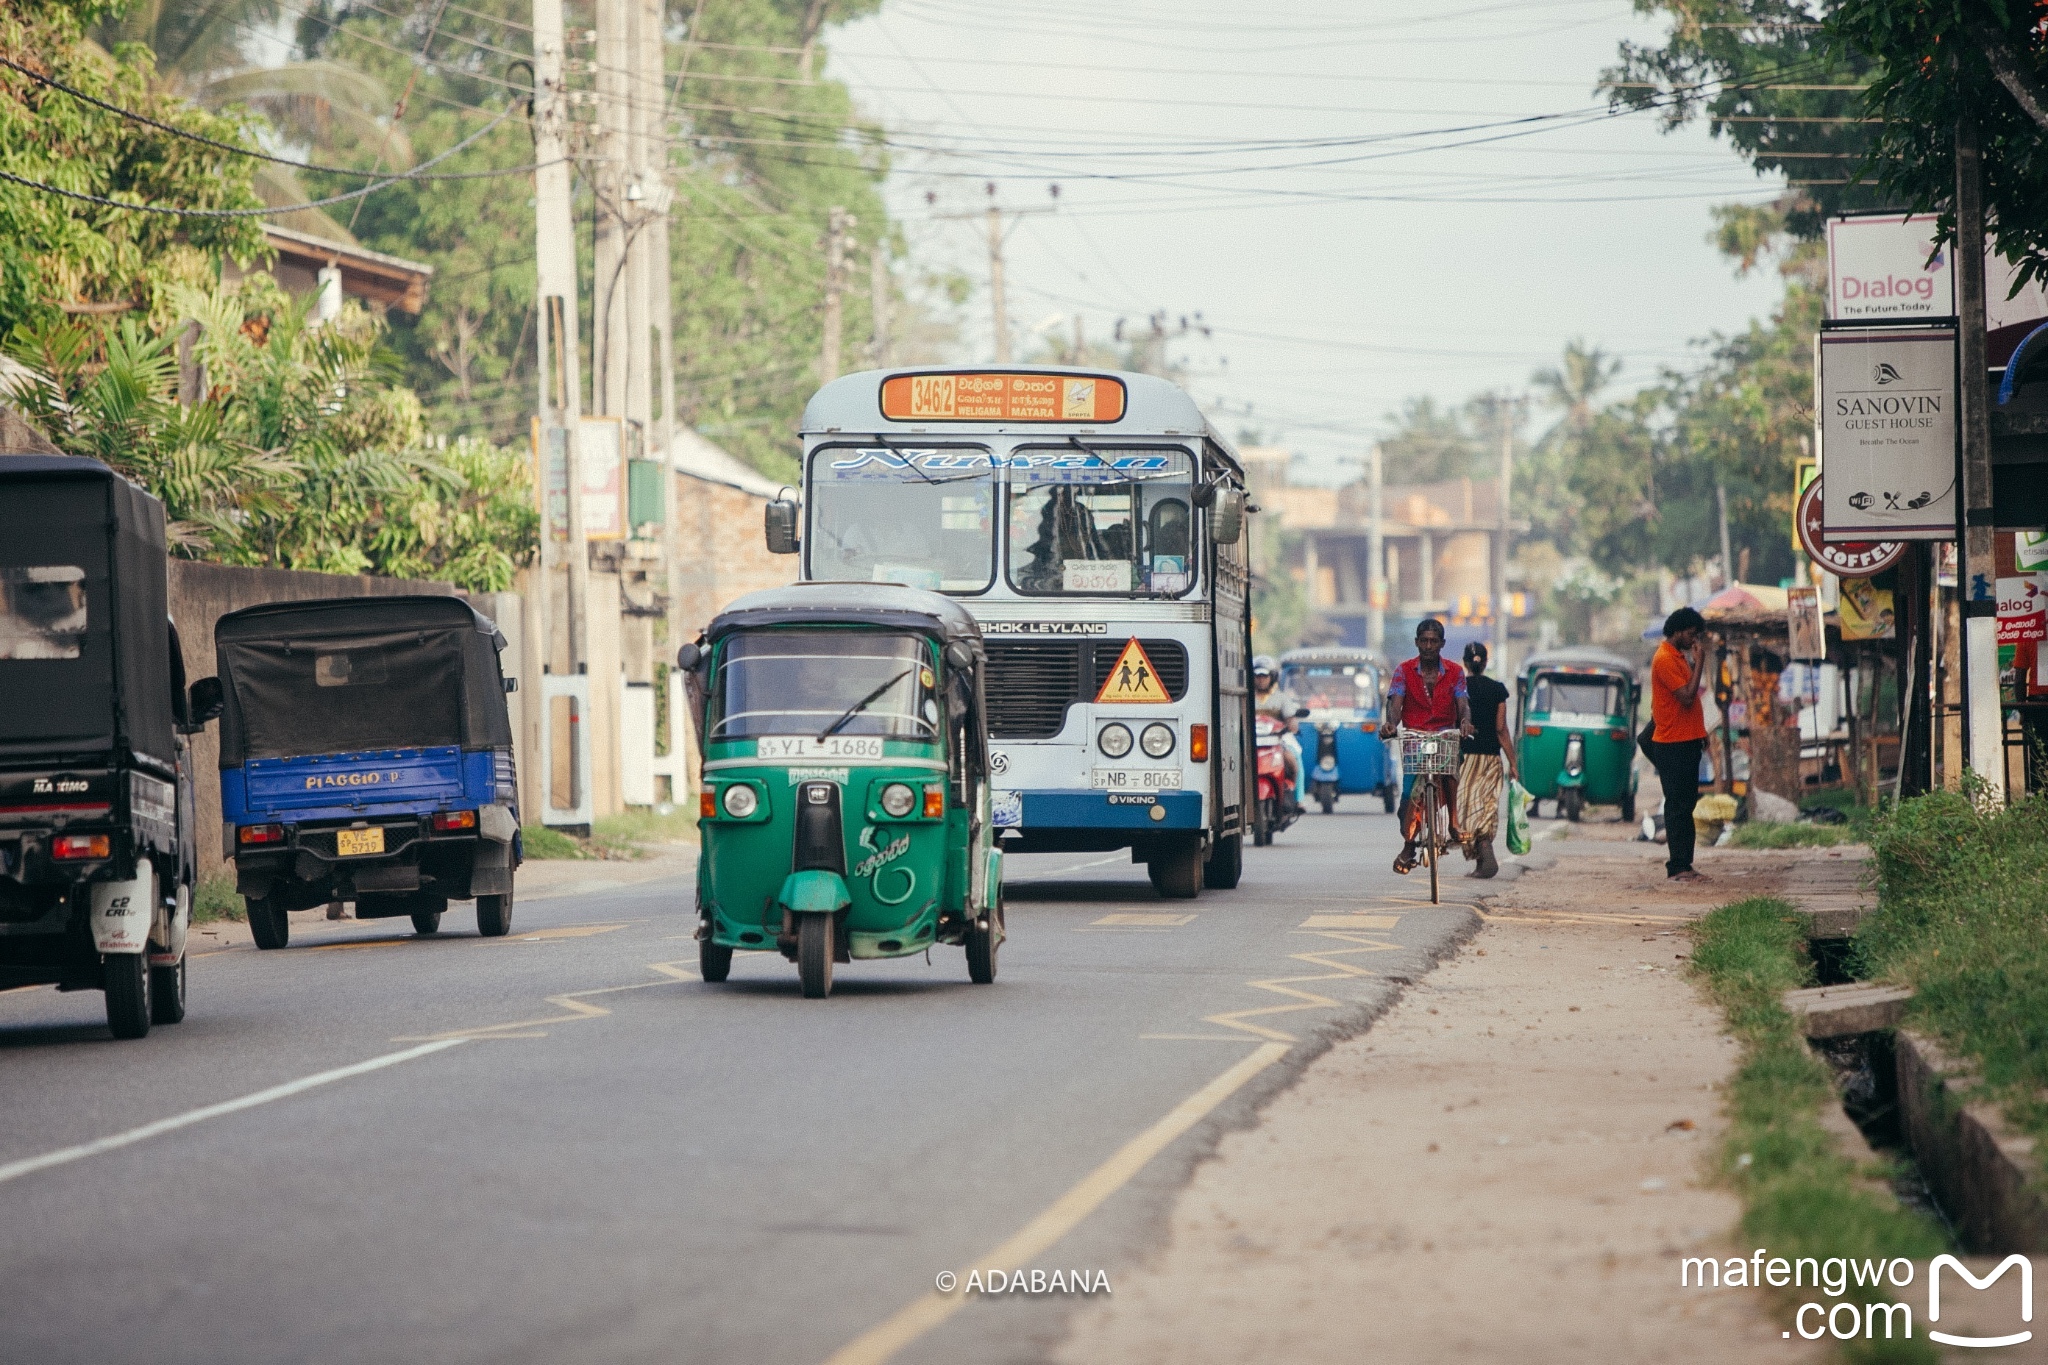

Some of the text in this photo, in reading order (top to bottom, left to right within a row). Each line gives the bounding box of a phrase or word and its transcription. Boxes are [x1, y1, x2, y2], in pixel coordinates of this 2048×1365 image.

[1842, 274, 1934, 300] Dialog
[1844, 306, 1862, 314] The
[1012, 379, 1056, 392] මාතර
[958, 406, 1002, 416] WELIGAMA
[1836, 395, 1942, 416] SANOVIN
[1011, 407, 1054, 417] MATARA
[1845, 417, 1933, 430] GUEST HOUSE
[1859, 438, 1884, 446] Breathe
[1899, 437, 1920, 445] Ocean
[979, 622, 1106, 633] SHOK LEYLAND
[782, 739, 805, 755] YI
[830, 739, 879, 756] 1686
[305, 772, 380, 790] PIAGGIO
[1094, 778, 1106, 786] SP
[1107, 772, 1127, 787] NB
[1144, 772, 1180, 787] 8063
[1119, 796, 1156, 804] VIKING
[352, 842, 377, 853] 5719
[111, 896, 131, 908] C2
